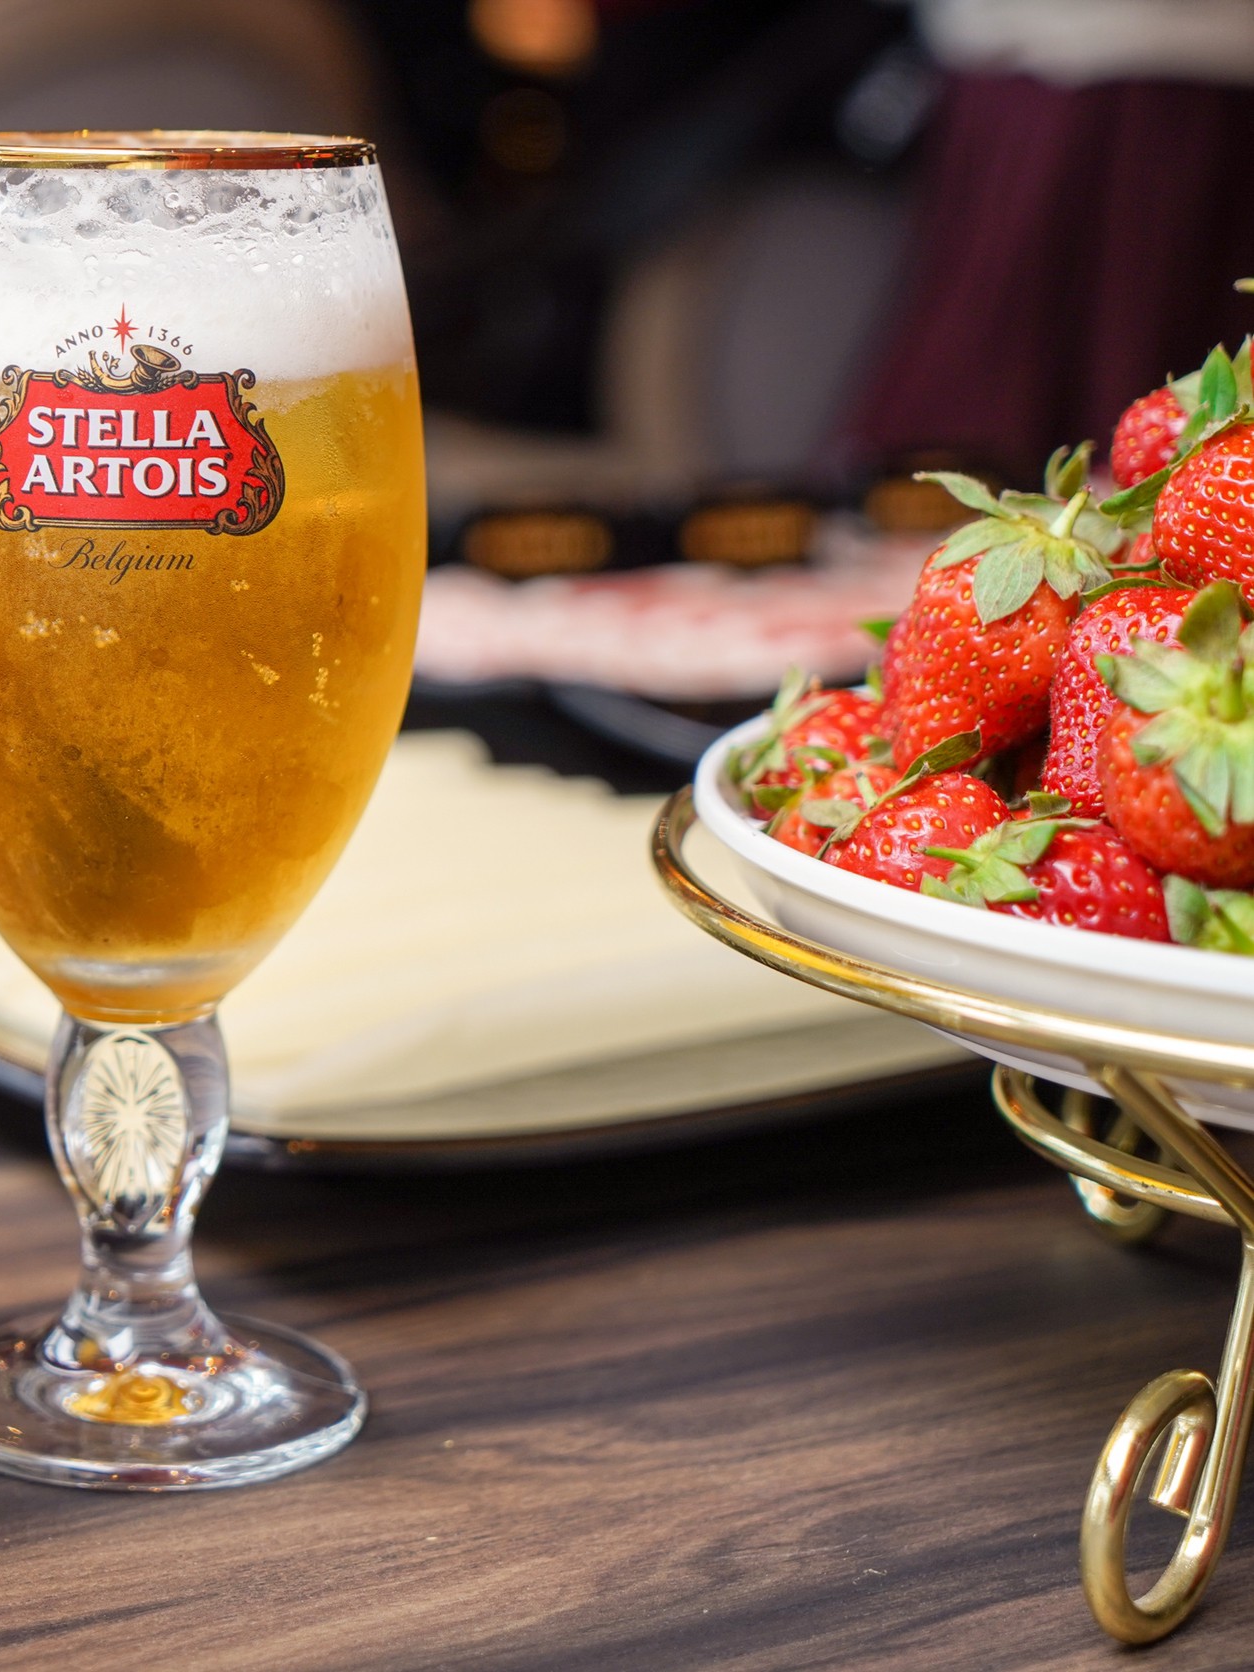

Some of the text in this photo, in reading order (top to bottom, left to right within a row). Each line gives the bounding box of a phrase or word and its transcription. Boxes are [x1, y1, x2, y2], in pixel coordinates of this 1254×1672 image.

[54, 324, 195, 358] ANNO 1366
[27, 406, 230, 449] STELLA
[20, 453, 230, 498] ARTOIS
[48, 537, 195, 585] Belgium
